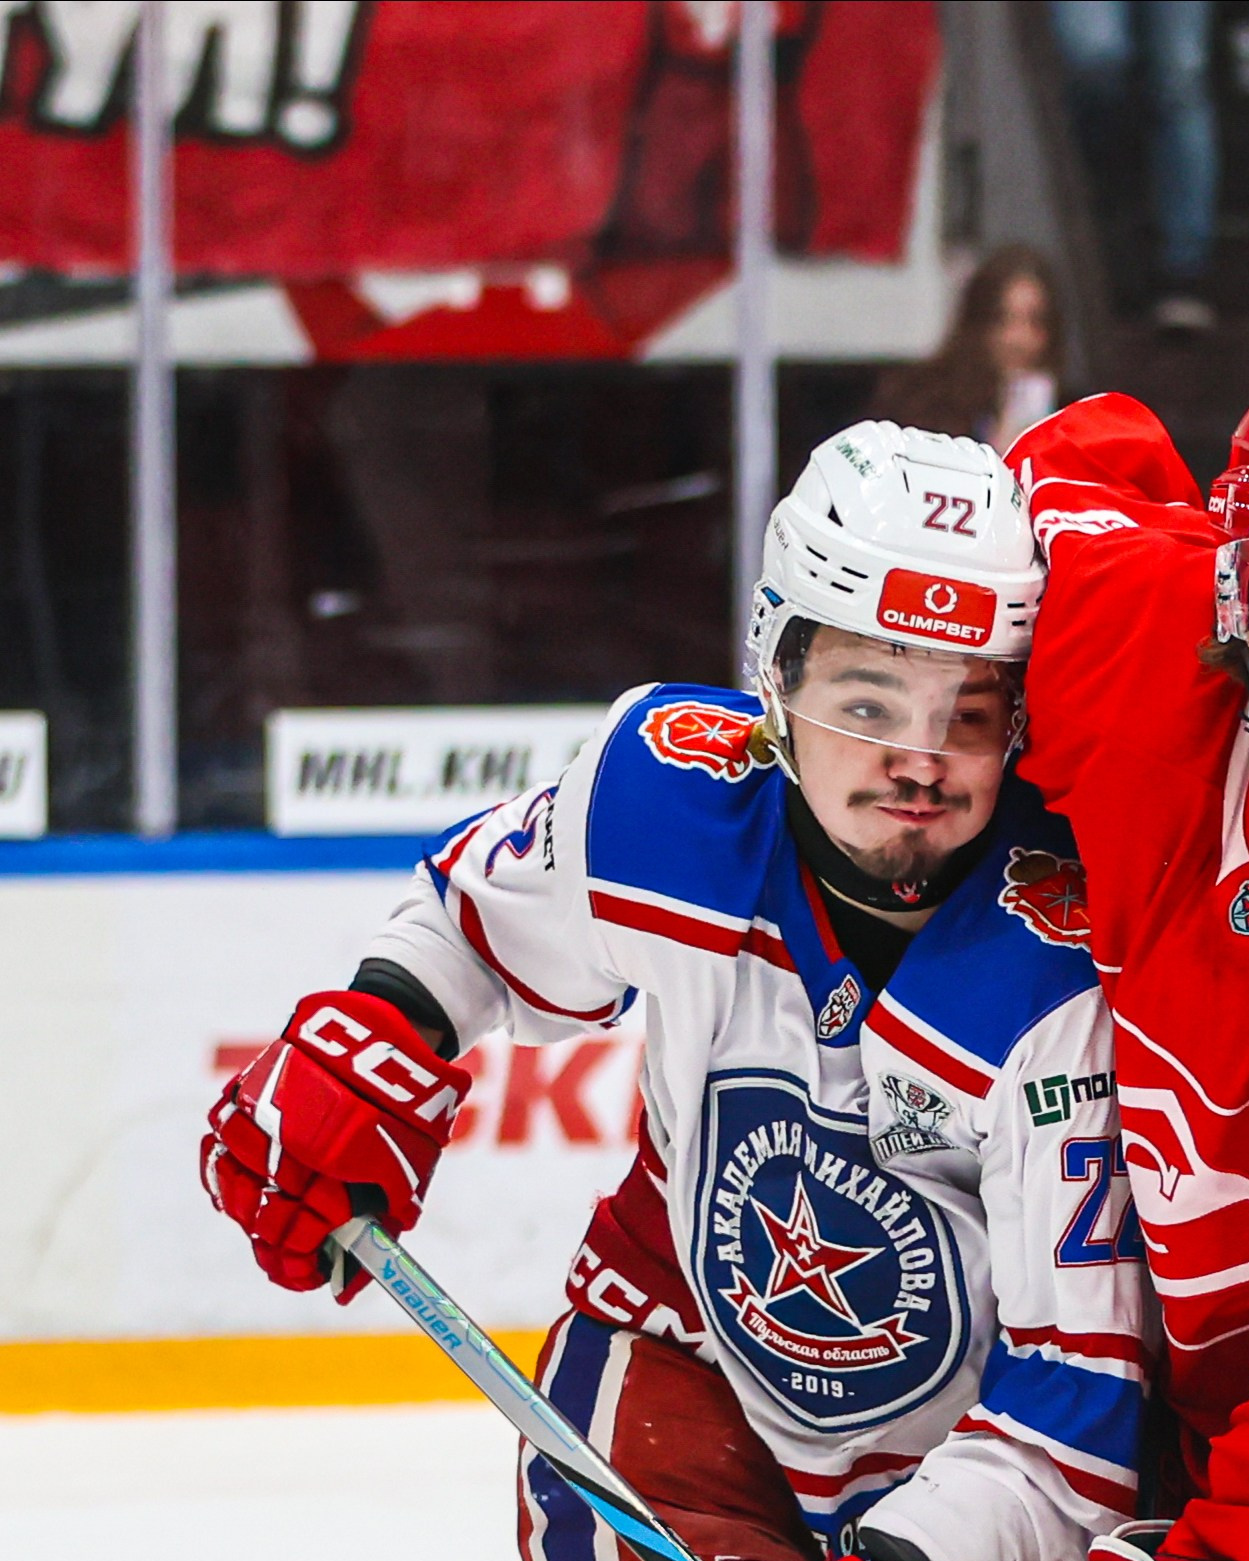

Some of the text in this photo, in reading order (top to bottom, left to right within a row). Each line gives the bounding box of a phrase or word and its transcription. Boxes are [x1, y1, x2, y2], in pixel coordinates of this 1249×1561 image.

[922, 491, 977, 538] 22
[882, 609, 985, 641] OLIMPBET
[714, 1120, 936, 1313] АКАДЕМИЯ МИХАЙЛОВА
[568, 1242, 719, 1364] CCM
[747, 1311, 890, 1361] Тульская область
